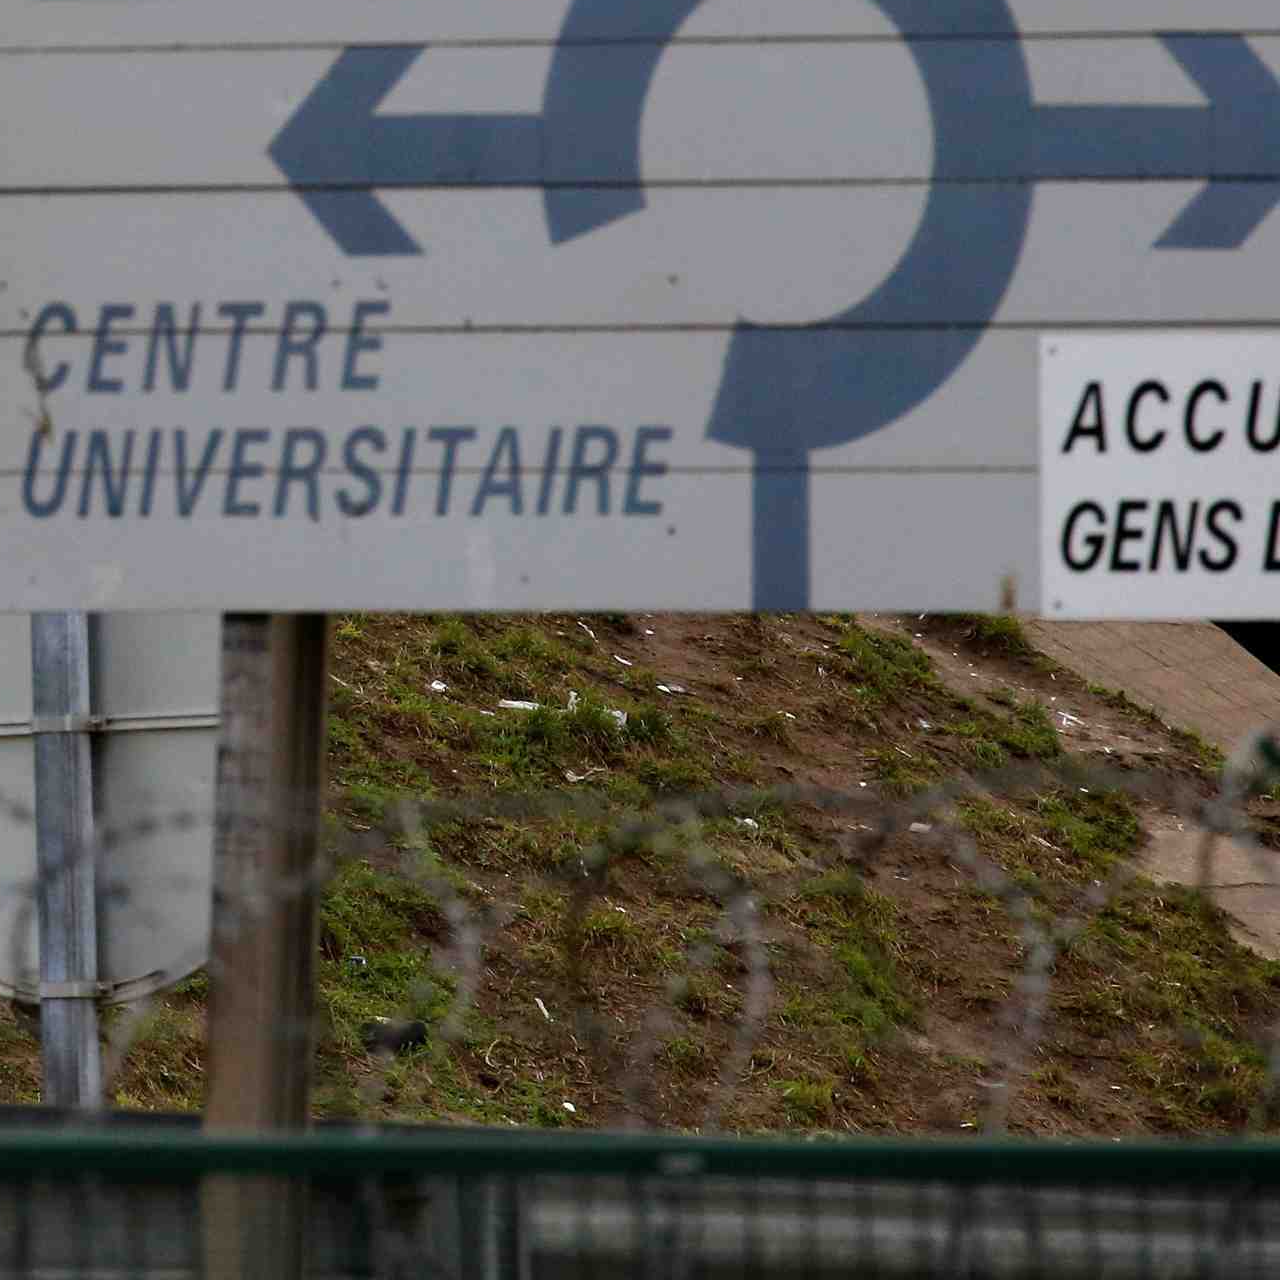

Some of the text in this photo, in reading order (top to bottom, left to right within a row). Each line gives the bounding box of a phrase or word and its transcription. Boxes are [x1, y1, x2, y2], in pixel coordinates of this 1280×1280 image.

[24, 300, 391, 394] CENTRE
[20, 425, 673, 520] UNIVERSITAIRE
[1060, 499, 1245, 573] GENS
